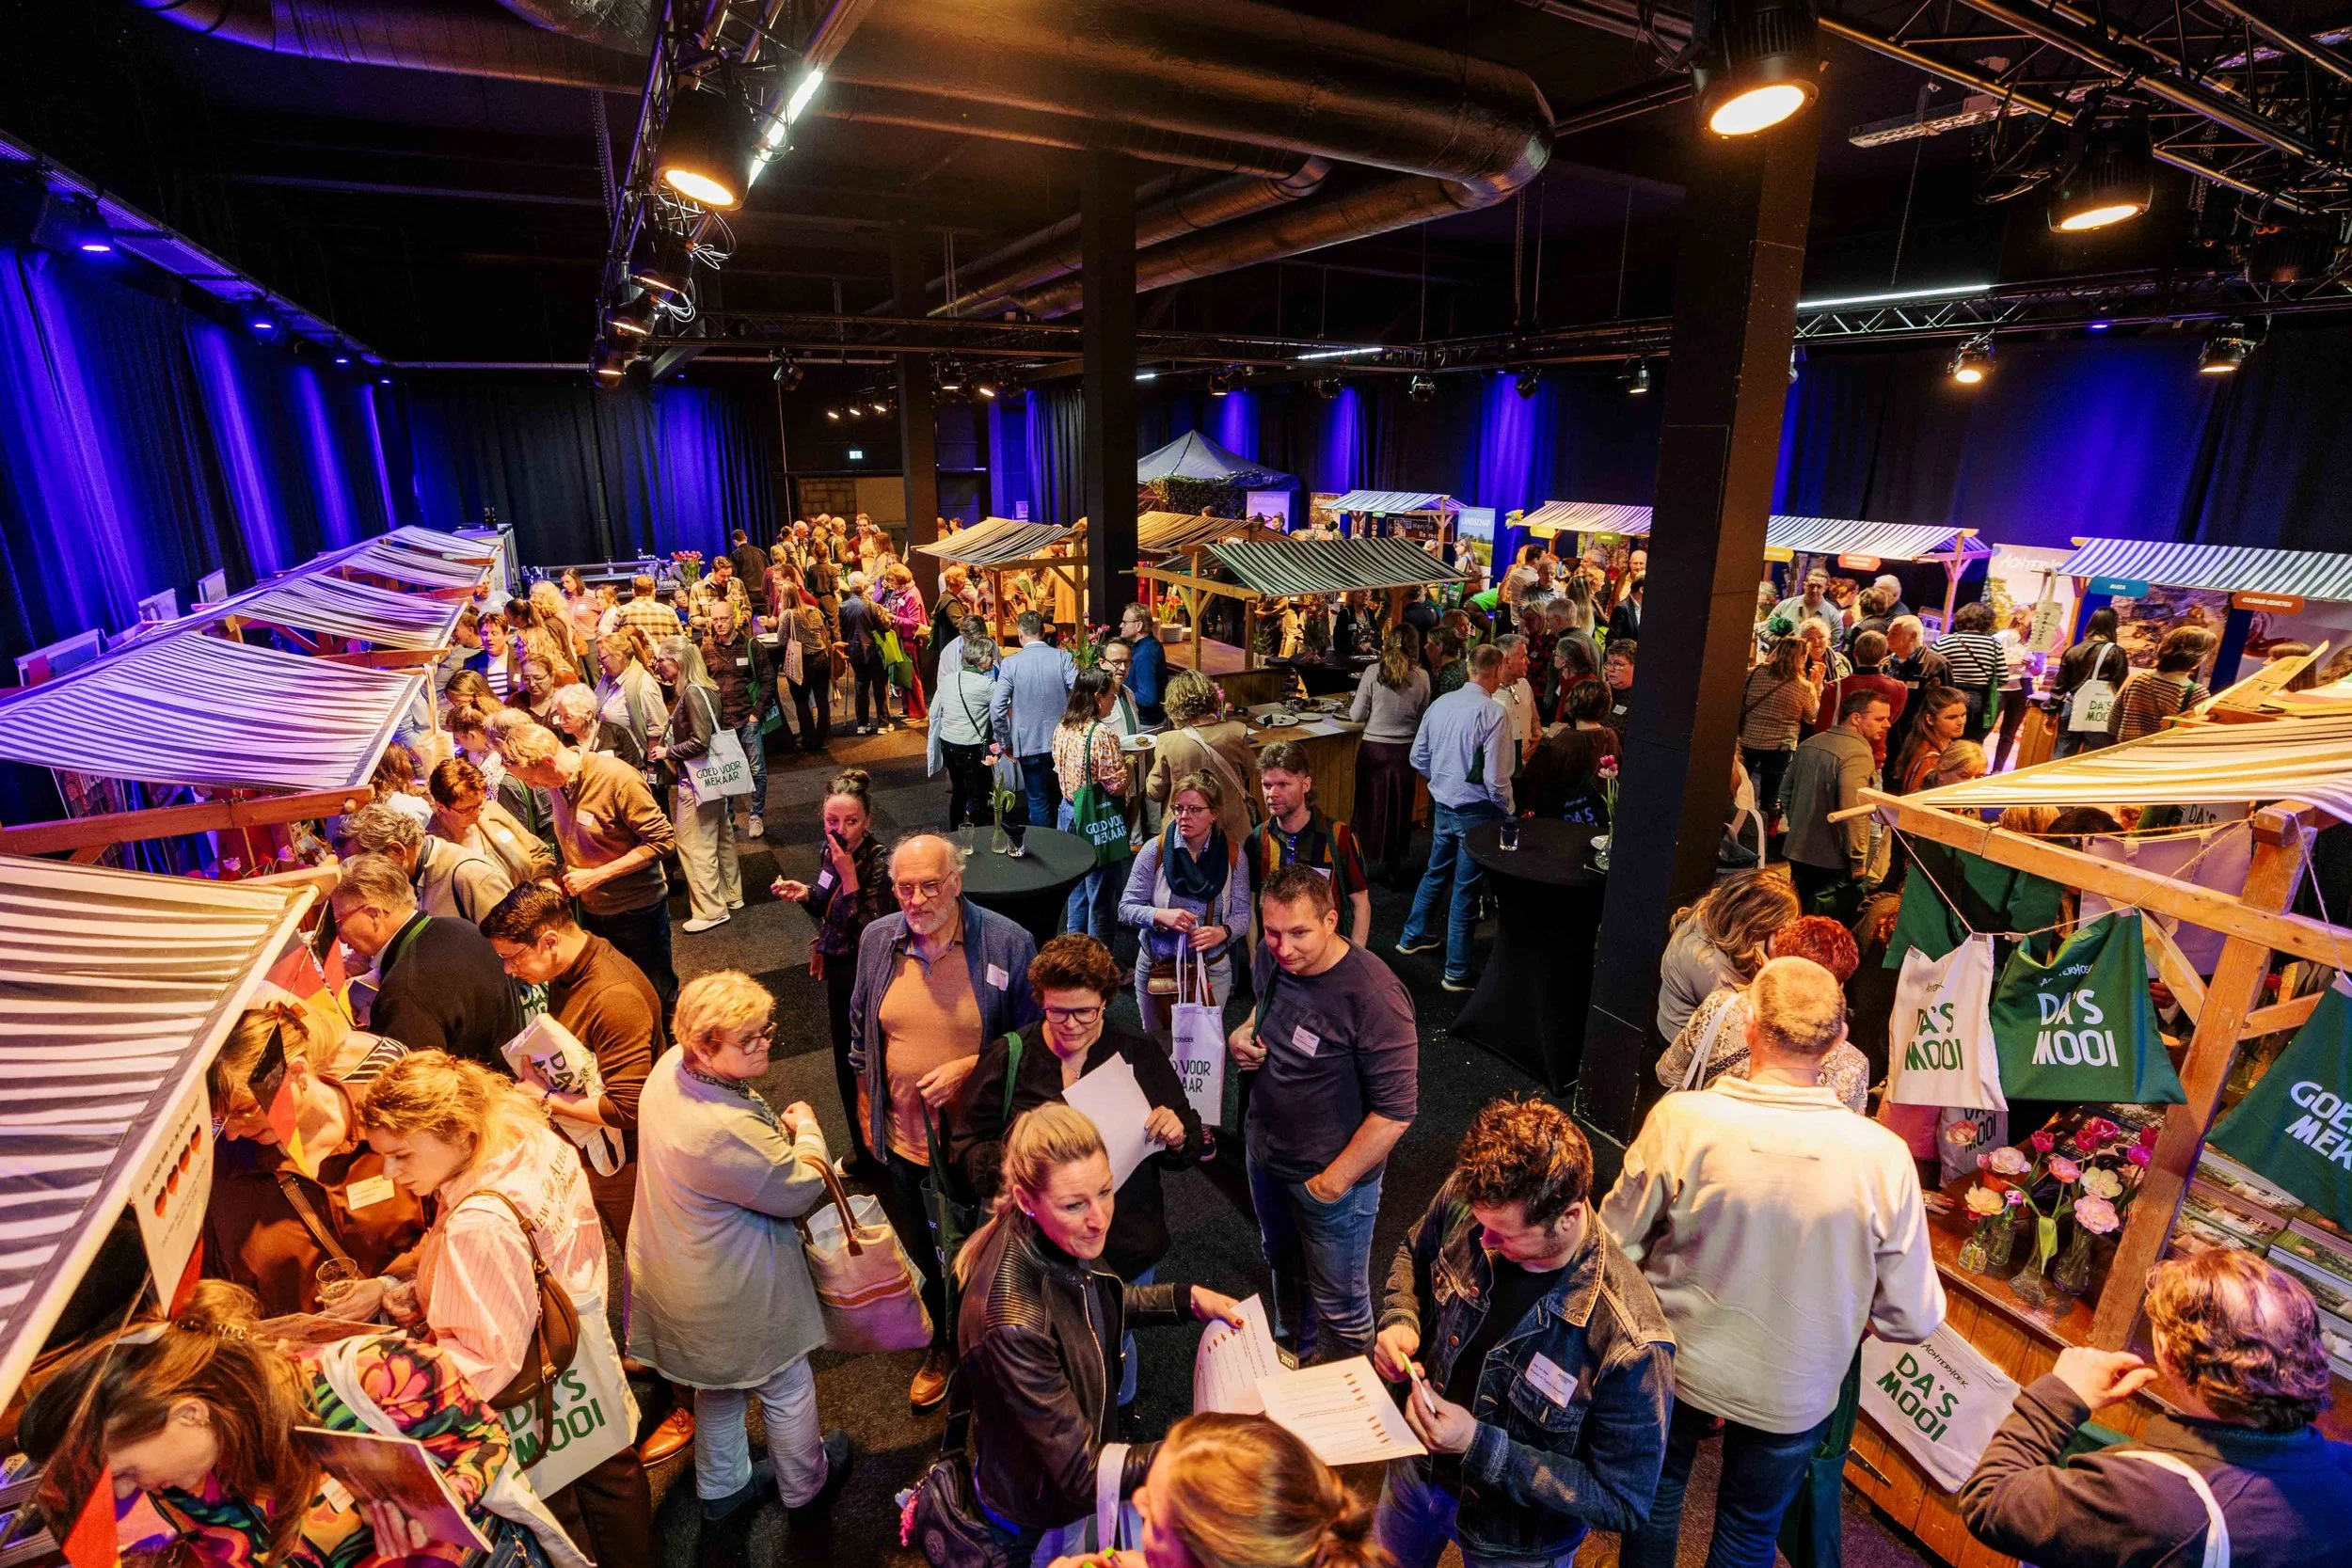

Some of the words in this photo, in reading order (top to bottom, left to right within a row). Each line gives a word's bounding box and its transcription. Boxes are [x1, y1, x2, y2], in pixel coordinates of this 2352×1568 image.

[2085, 711, 2109, 722] MOO
[696, 767, 719, 779] GOED
[719, 760, 742, 775] VOOR
[704, 771, 740, 788] MEKAAR
[1107, 814, 1124, 829] VOO
[2036, 989, 2105, 1026] DA'S
[1904, 1037, 1964, 1071] MOOI
[2031, 1029, 2120, 1068] MOOI
[1180, 1059, 1212, 1077] VOOR
[1181, 1077, 1204, 1093] AAR
[2290, 1080, 2352, 1135] GOE
[1920, 1342, 1969, 1389] ACHTERHOEK
[1895, 1352, 1960, 1418] DA'S
[1875, 1370, 1948, 1443] MOOI
